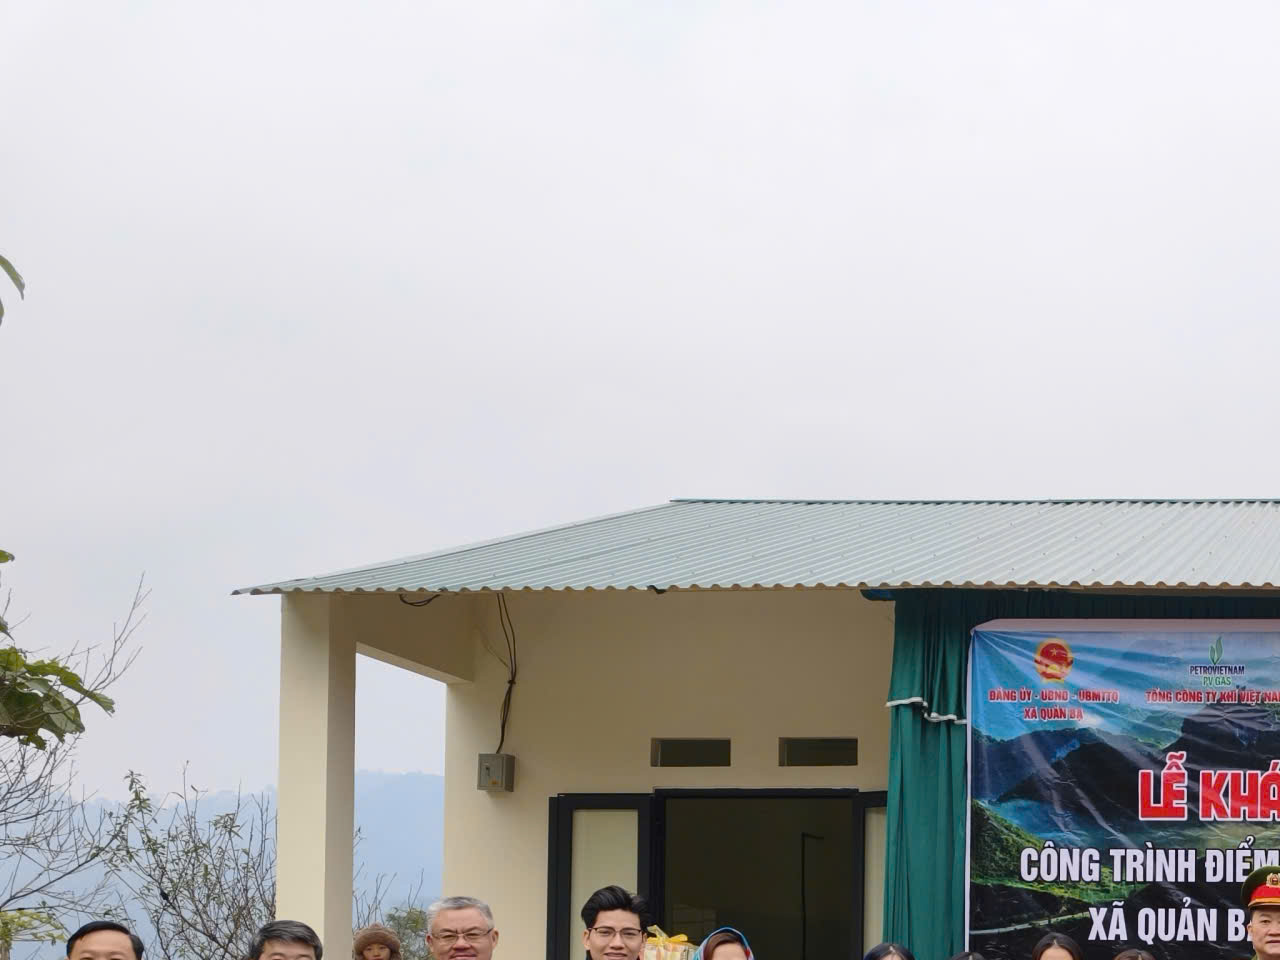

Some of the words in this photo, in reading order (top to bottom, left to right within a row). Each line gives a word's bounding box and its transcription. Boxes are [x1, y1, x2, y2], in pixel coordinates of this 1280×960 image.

[1190, 665, 1245, 675] PETROVIETNAM
[1203, 677, 1215, 685] PV
[1215, 677, 1232, 685] GAS
[1041, 690, 1068, 702] UBND
[1145, 687, 1173, 702] TỔNG
[1175, 689, 1203, 702] CÔNG
[1206, 691, 1217, 703] TY
[1219, 689, 1237, 702] KHÍ
[1239, 690, 1262, 705] VIỆT
[1138, 751, 1188, 821] LỄ
[1020, 841, 1100, 883] CÔNG
[1109, 841, 1196, 883] TRÌNH
[1205, 836, 1280, 883] ĐIỂM
[1088, 901, 1128, 941] XÃ
[1137, 897, 1218, 945] QUẢN
[1228, 908, 1252, 941] B
